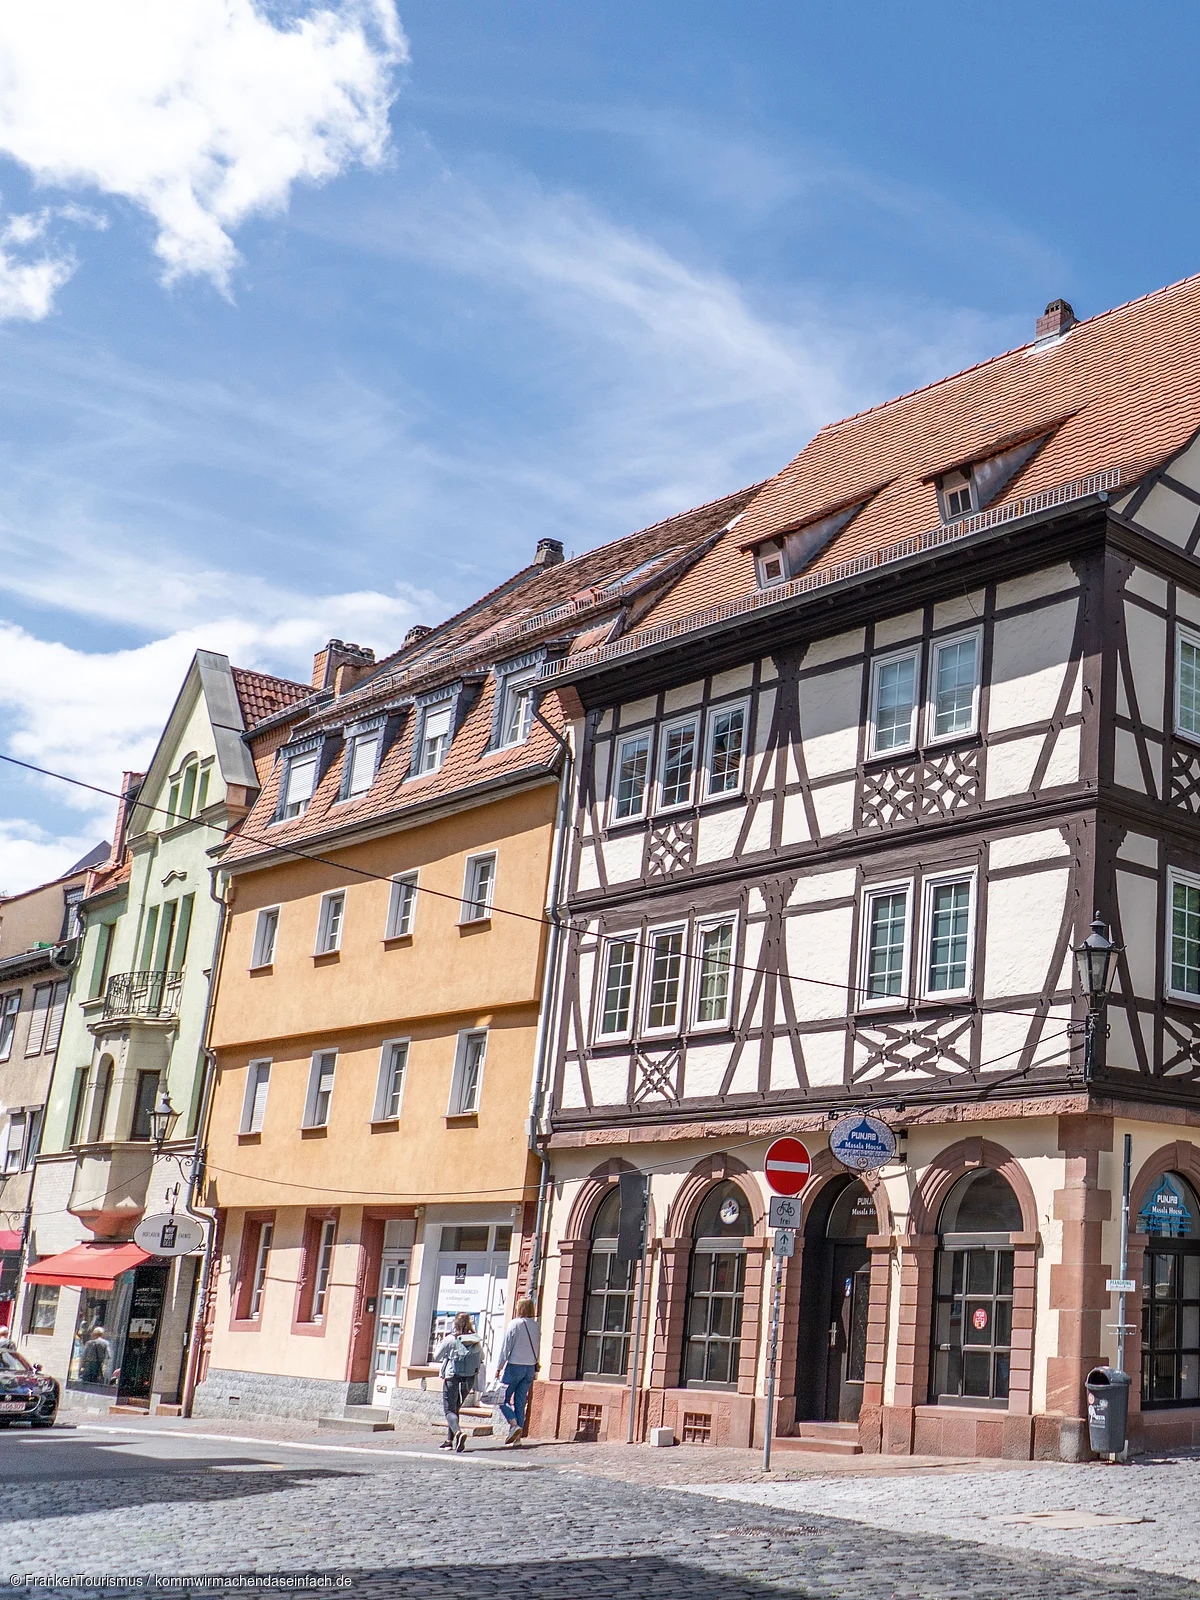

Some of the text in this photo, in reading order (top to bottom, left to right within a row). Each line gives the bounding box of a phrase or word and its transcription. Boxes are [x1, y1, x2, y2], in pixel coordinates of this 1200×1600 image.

[851, 1131, 877, 1141] PUNJAB
[844, 1141, 882, 1151] Masala House
[1156, 1194, 1178, 1204] PUNJAB
[868, 1208, 877, 1216] Ho
[779, 1217, 791, 1225] frei
